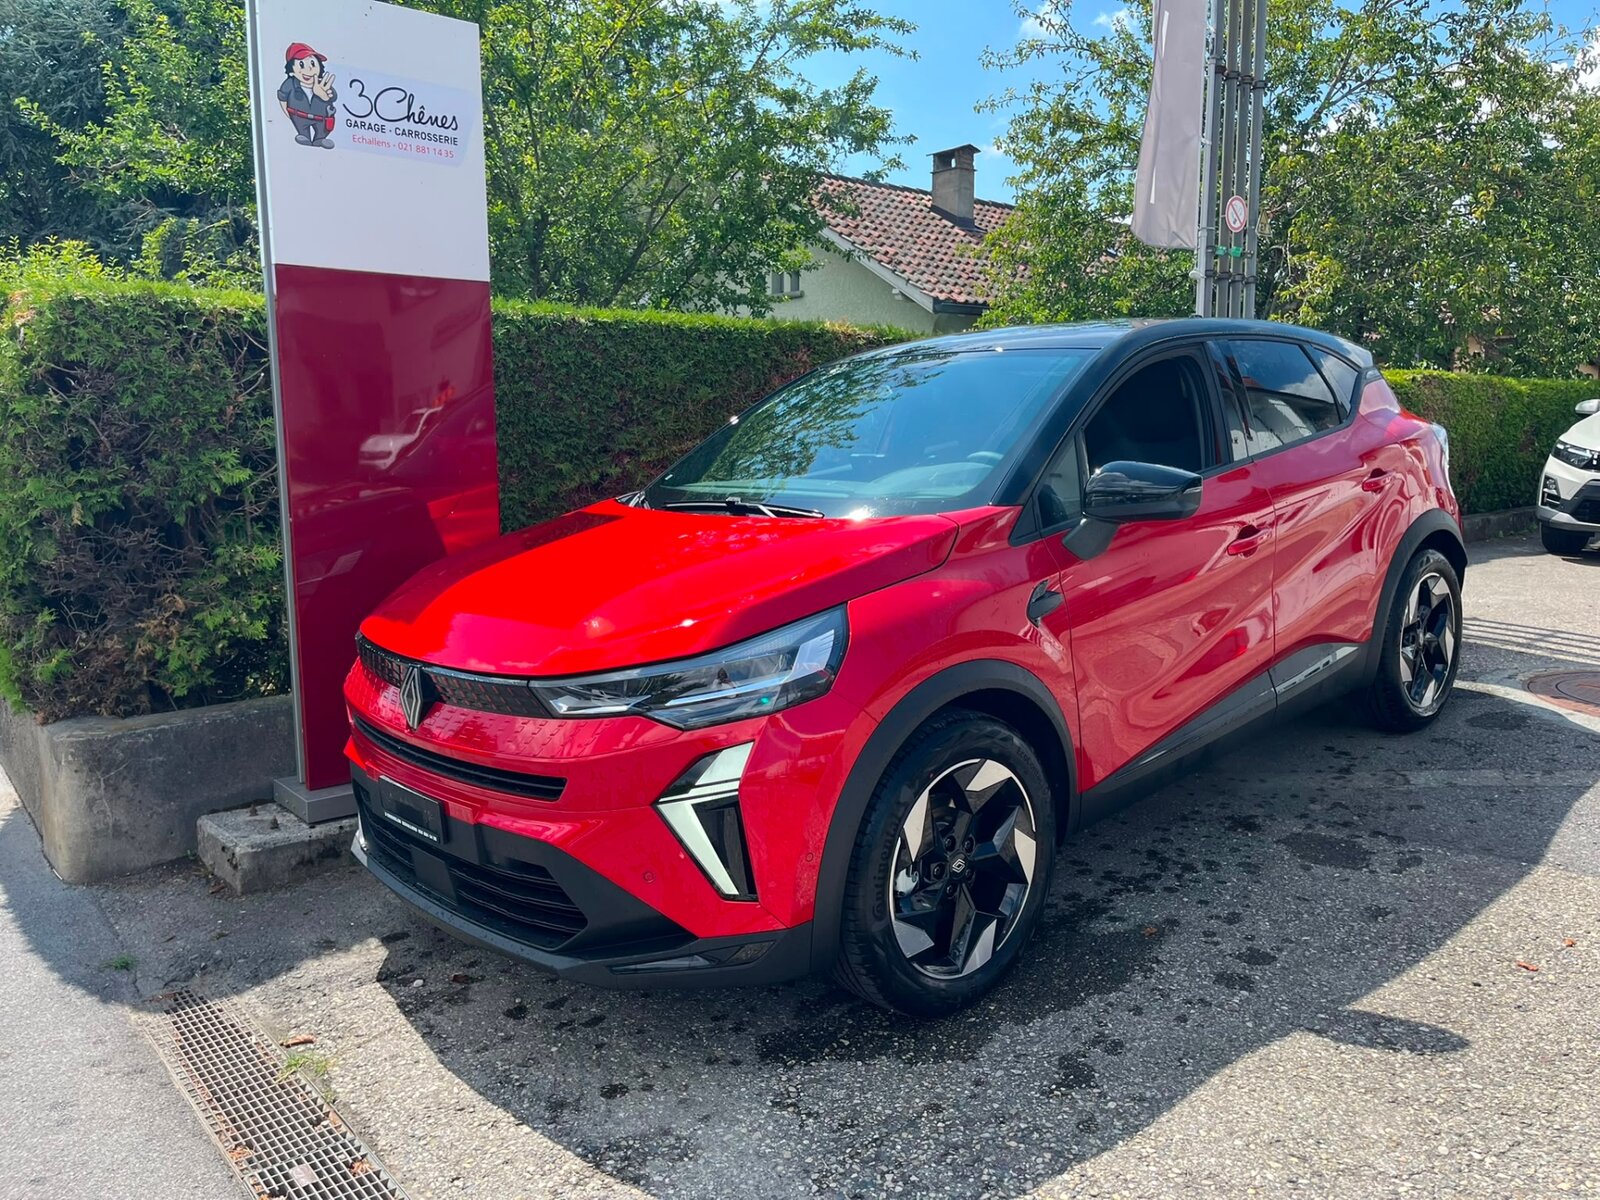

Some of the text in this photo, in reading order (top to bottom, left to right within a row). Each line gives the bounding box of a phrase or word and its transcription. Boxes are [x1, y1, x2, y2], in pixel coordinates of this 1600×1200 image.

[345, 118, 386, 134] GARAGE
[395, 127, 458, 146] CARROSSERIE
[352, 134, 391, 149] Echallens
[398, 141, 413, 152] 021
[415, 145, 430, 154] 881
